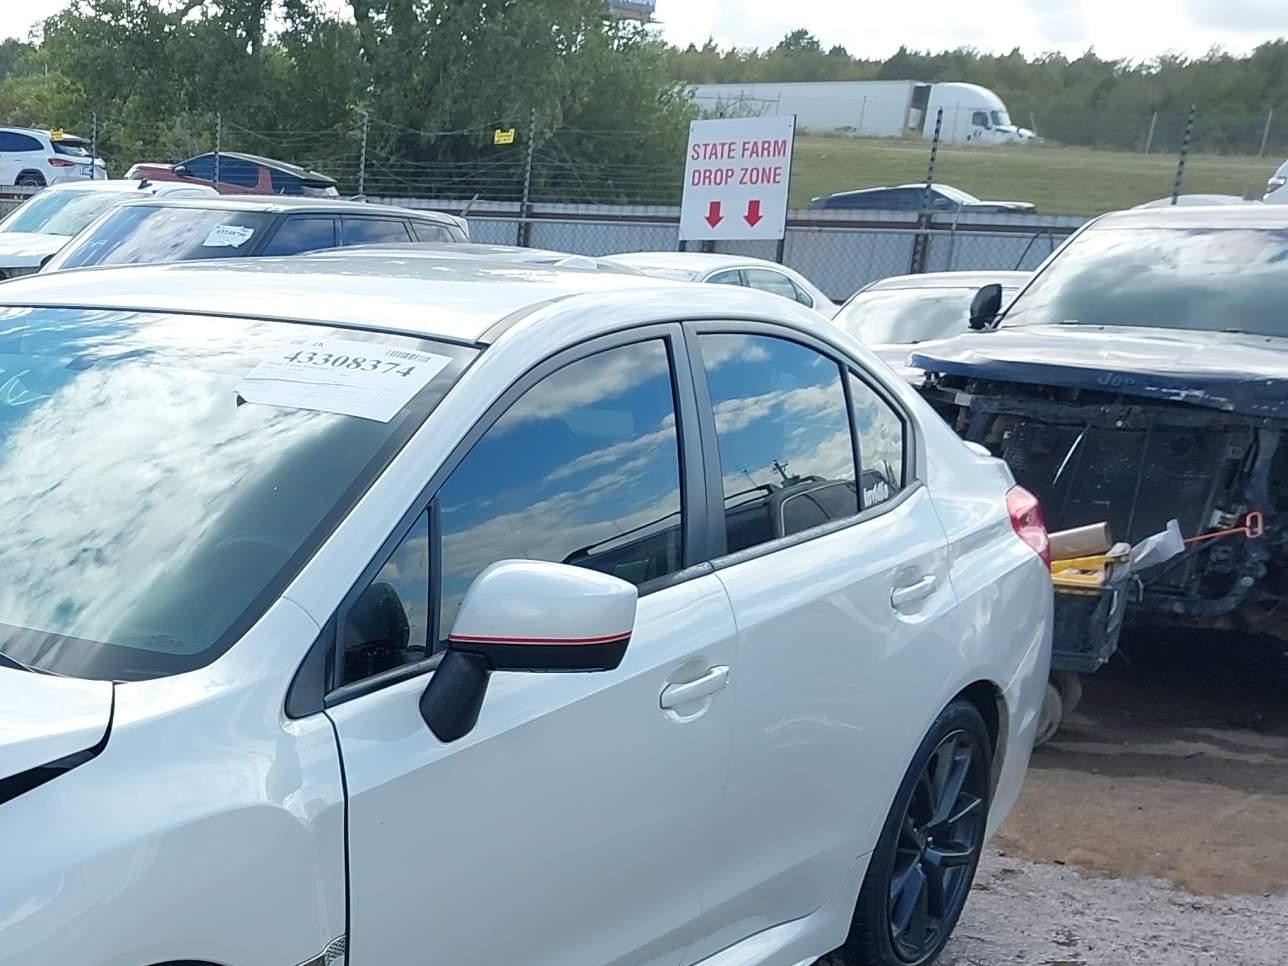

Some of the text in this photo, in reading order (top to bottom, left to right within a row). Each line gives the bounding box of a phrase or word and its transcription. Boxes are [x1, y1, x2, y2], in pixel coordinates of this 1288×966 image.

[691, 139, 787, 160] STATE FARM
[691, 166, 782, 186] DROP ZONE
[283, 350, 417, 377] 43308374
